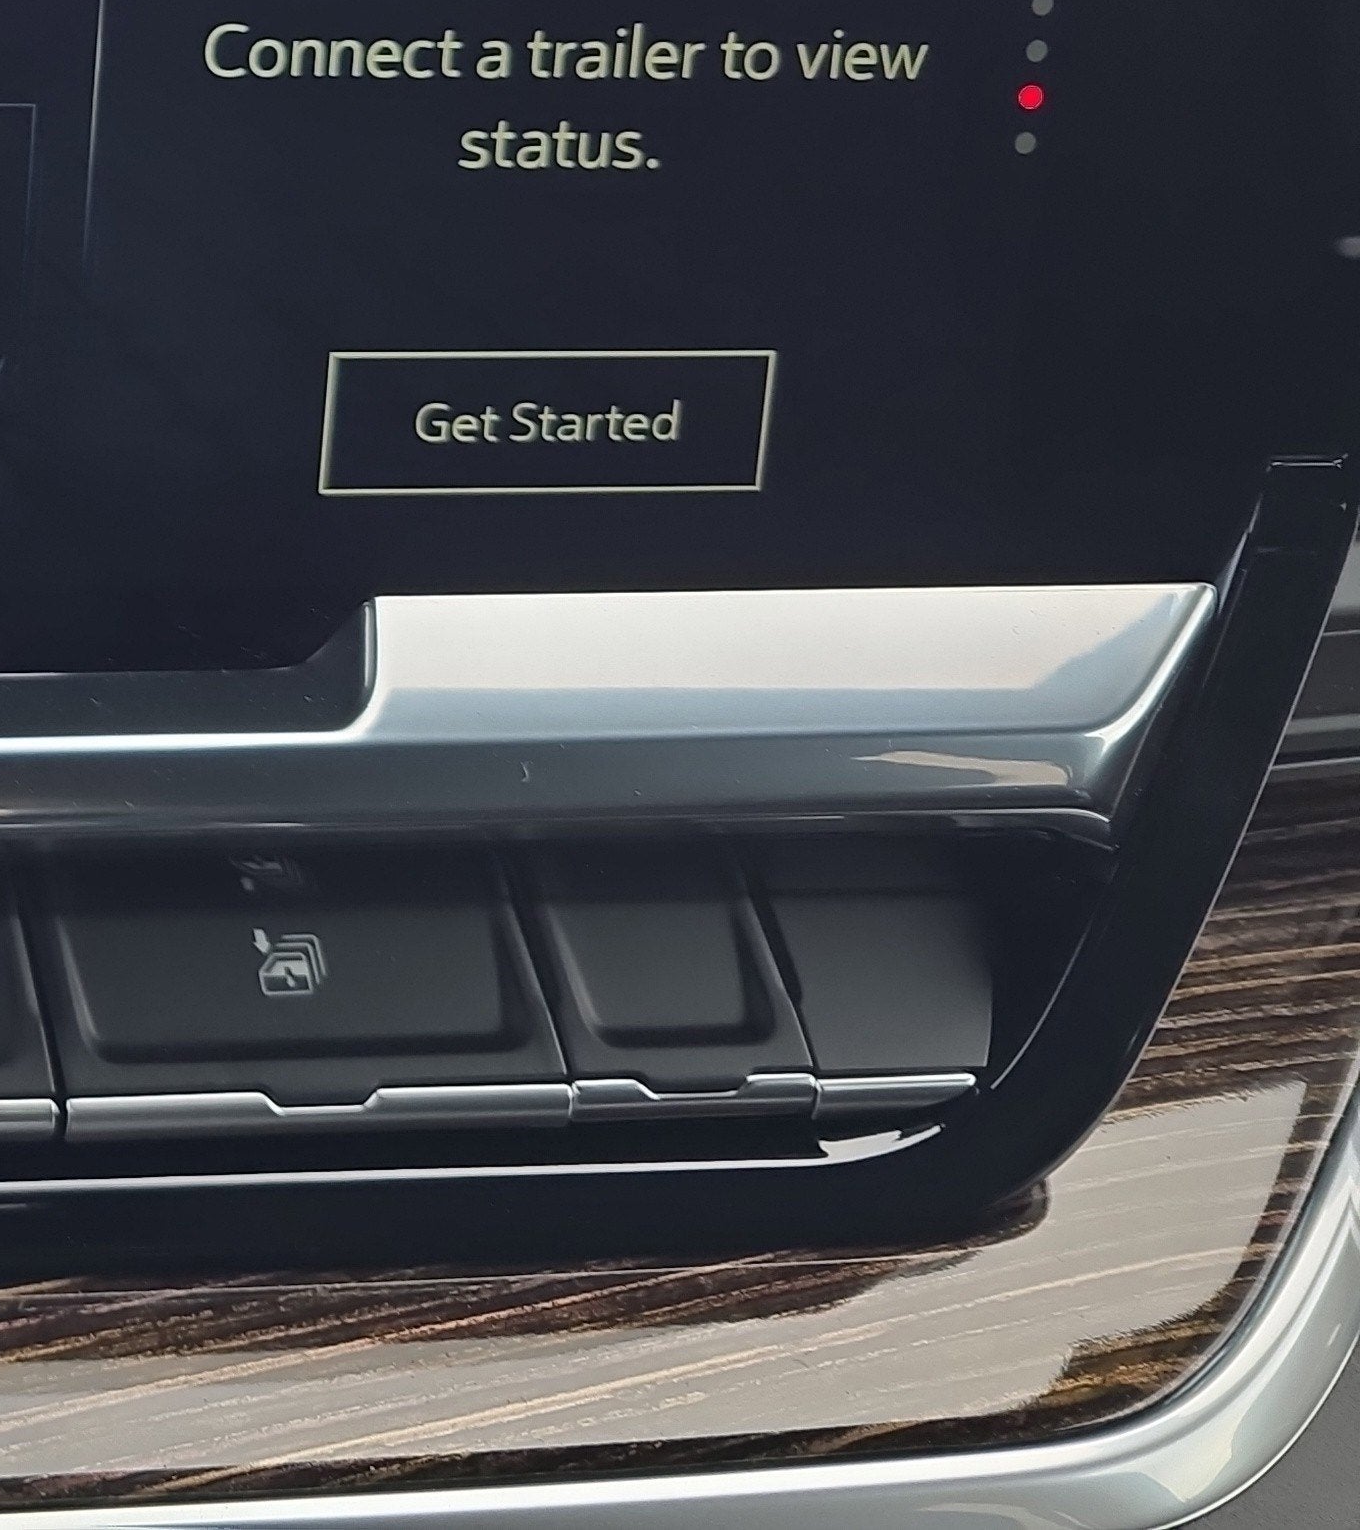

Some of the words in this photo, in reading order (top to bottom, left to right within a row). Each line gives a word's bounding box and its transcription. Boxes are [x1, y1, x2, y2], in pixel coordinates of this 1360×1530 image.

[204, 23, 464, 82] Connect
[476, 40, 512, 79] a
[526, 22, 707, 80] trailer
[720, 31, 780, 81] to
[796, 29, 929, 82] view
[457, 120, 659, 173] status.
[415, 400, 498, 443] Get
[508, 399, 681, 444] Started
